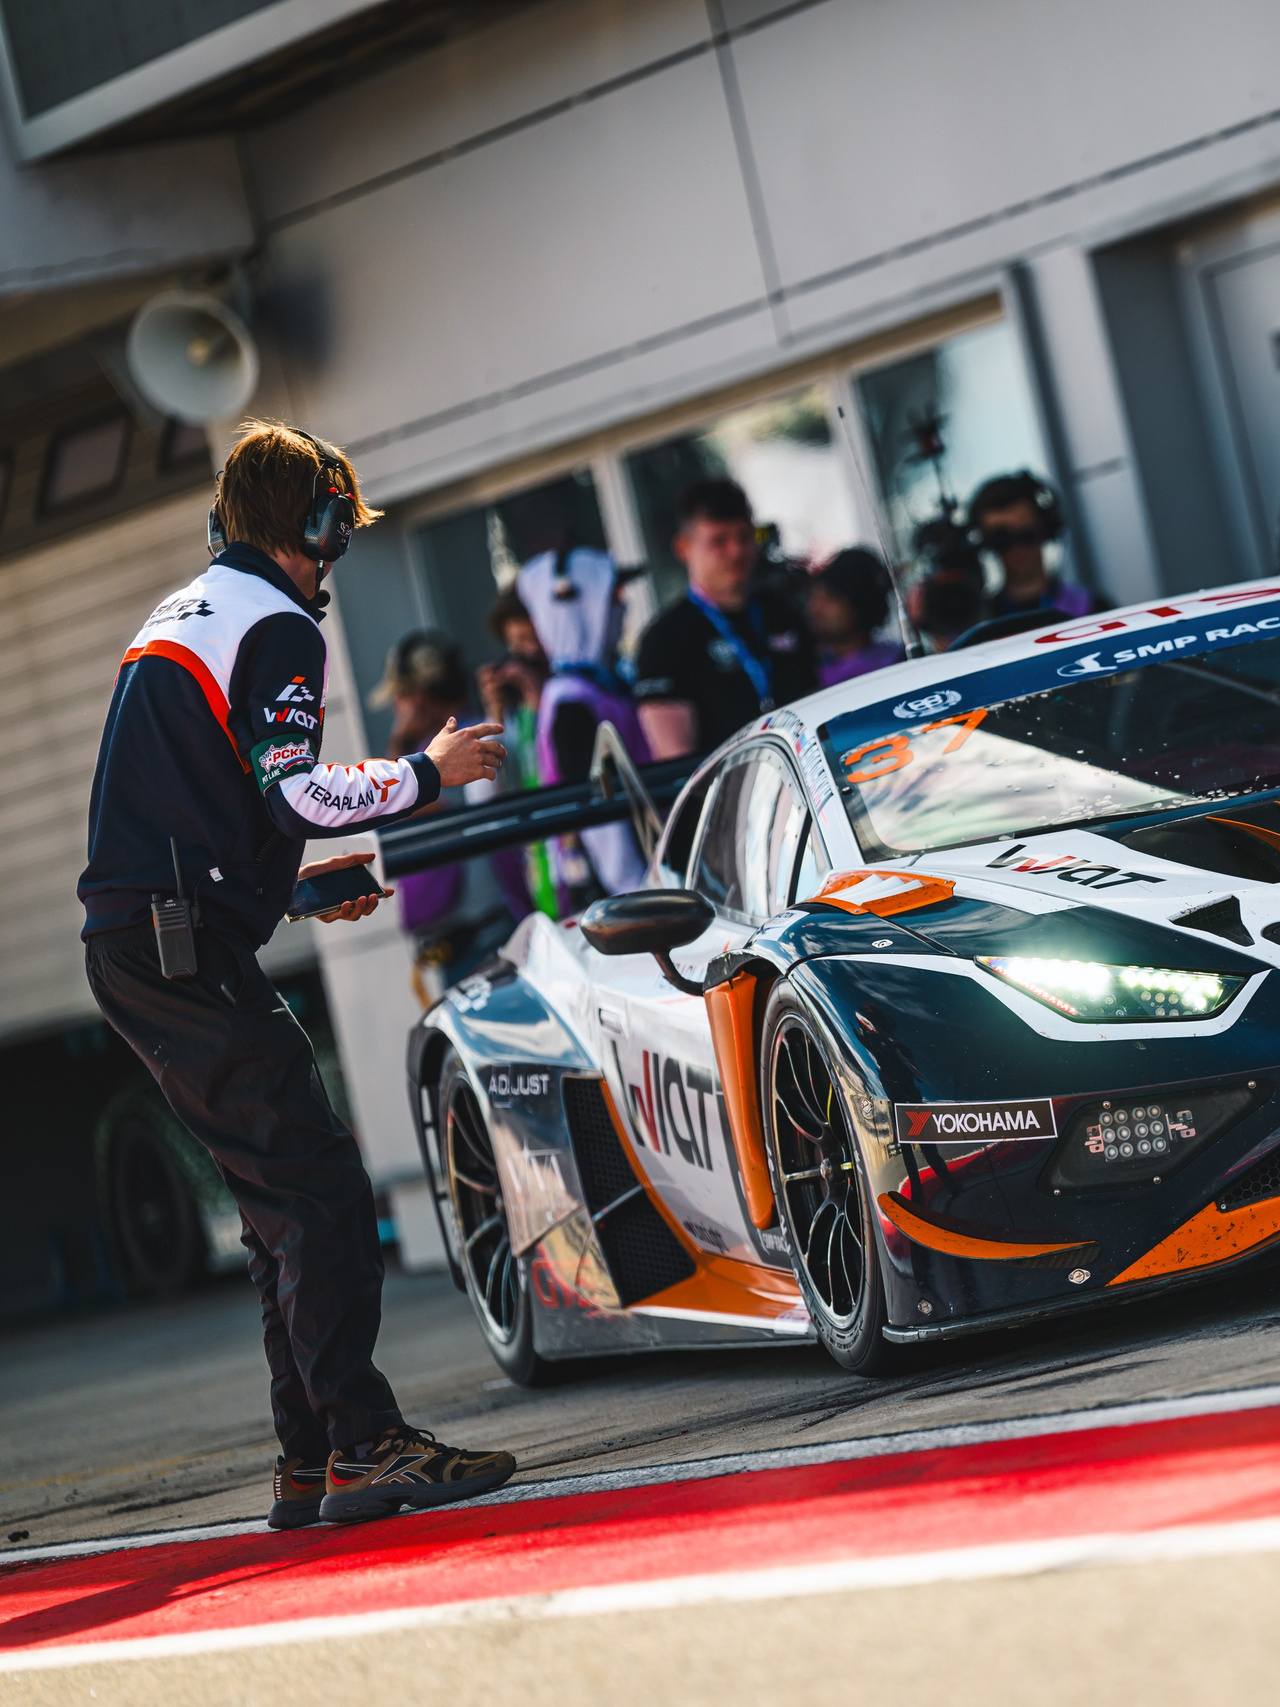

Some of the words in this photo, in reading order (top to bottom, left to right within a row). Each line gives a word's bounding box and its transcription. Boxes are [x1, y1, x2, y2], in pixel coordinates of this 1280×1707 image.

[1115, 635, 1198, 664] SMP
[845, 708, 988, 784] 37
[268, 768, 281, 780] LANE
[304, 780, 376, 811] TERAPLAN
[488, 1073, 550, 1096] ADJUST
[931, 1109, 1041, 1134] YOKOHAMA
